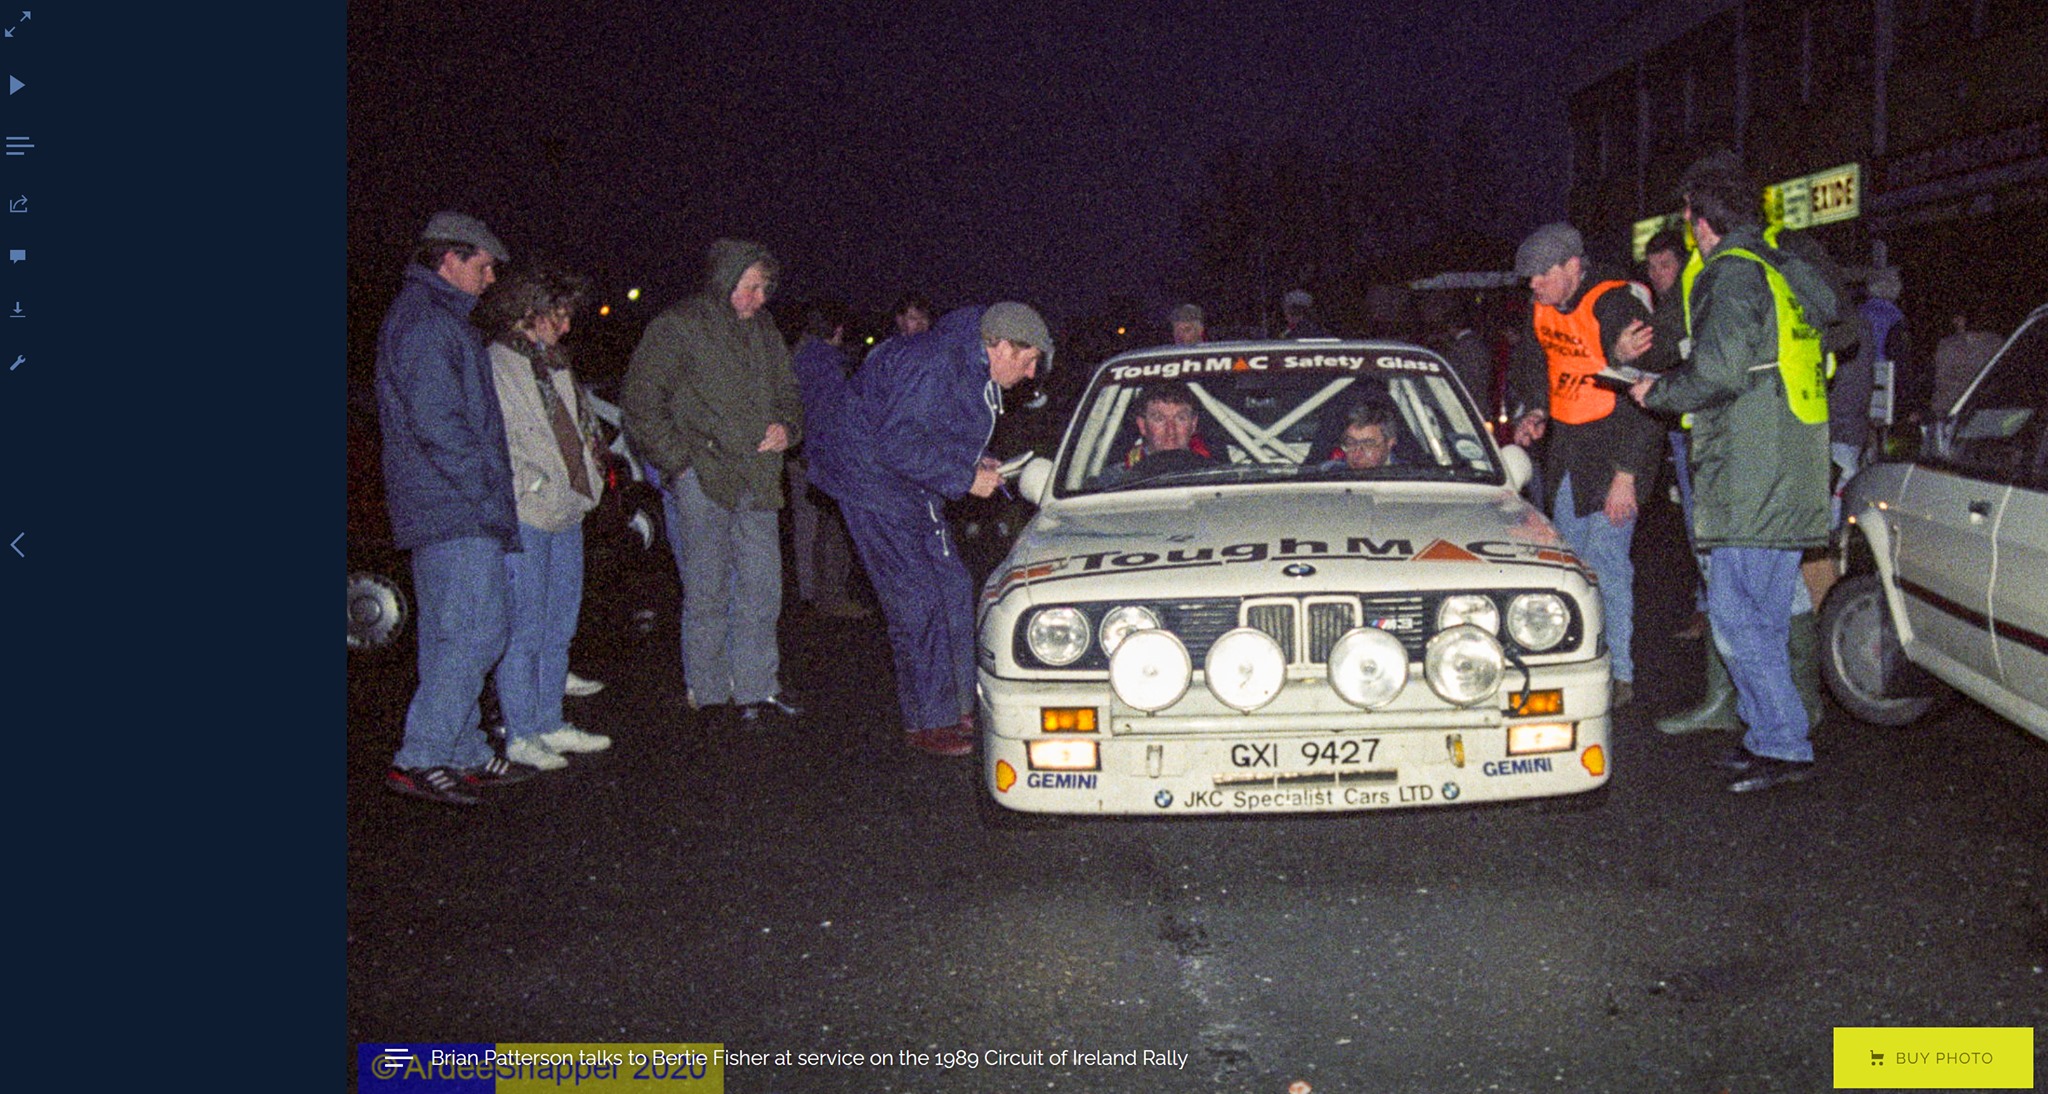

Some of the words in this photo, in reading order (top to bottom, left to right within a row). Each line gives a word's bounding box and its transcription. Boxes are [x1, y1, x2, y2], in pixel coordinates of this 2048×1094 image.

[1110, 359, 1201, 381] Tough
[1284, 354, 1364, 370] Safety
[1376, 356, 1440, 372] Glass
[1068, 537, 1328, 571] Tough
[1231, 743, 1278, 768] GXI
[1301, 738, 1380, 766] 9427
[1481, 757, 1553, 777] GEMINI
[1027, 773, 1097, 789] GEMINI
[1184, 790, 1223, 808] JKC
[1233, 788, 1333, 809] Specialist
[1344, 788, 1390, 805] Cars
[1399, 785, 1433, 802] LTD
